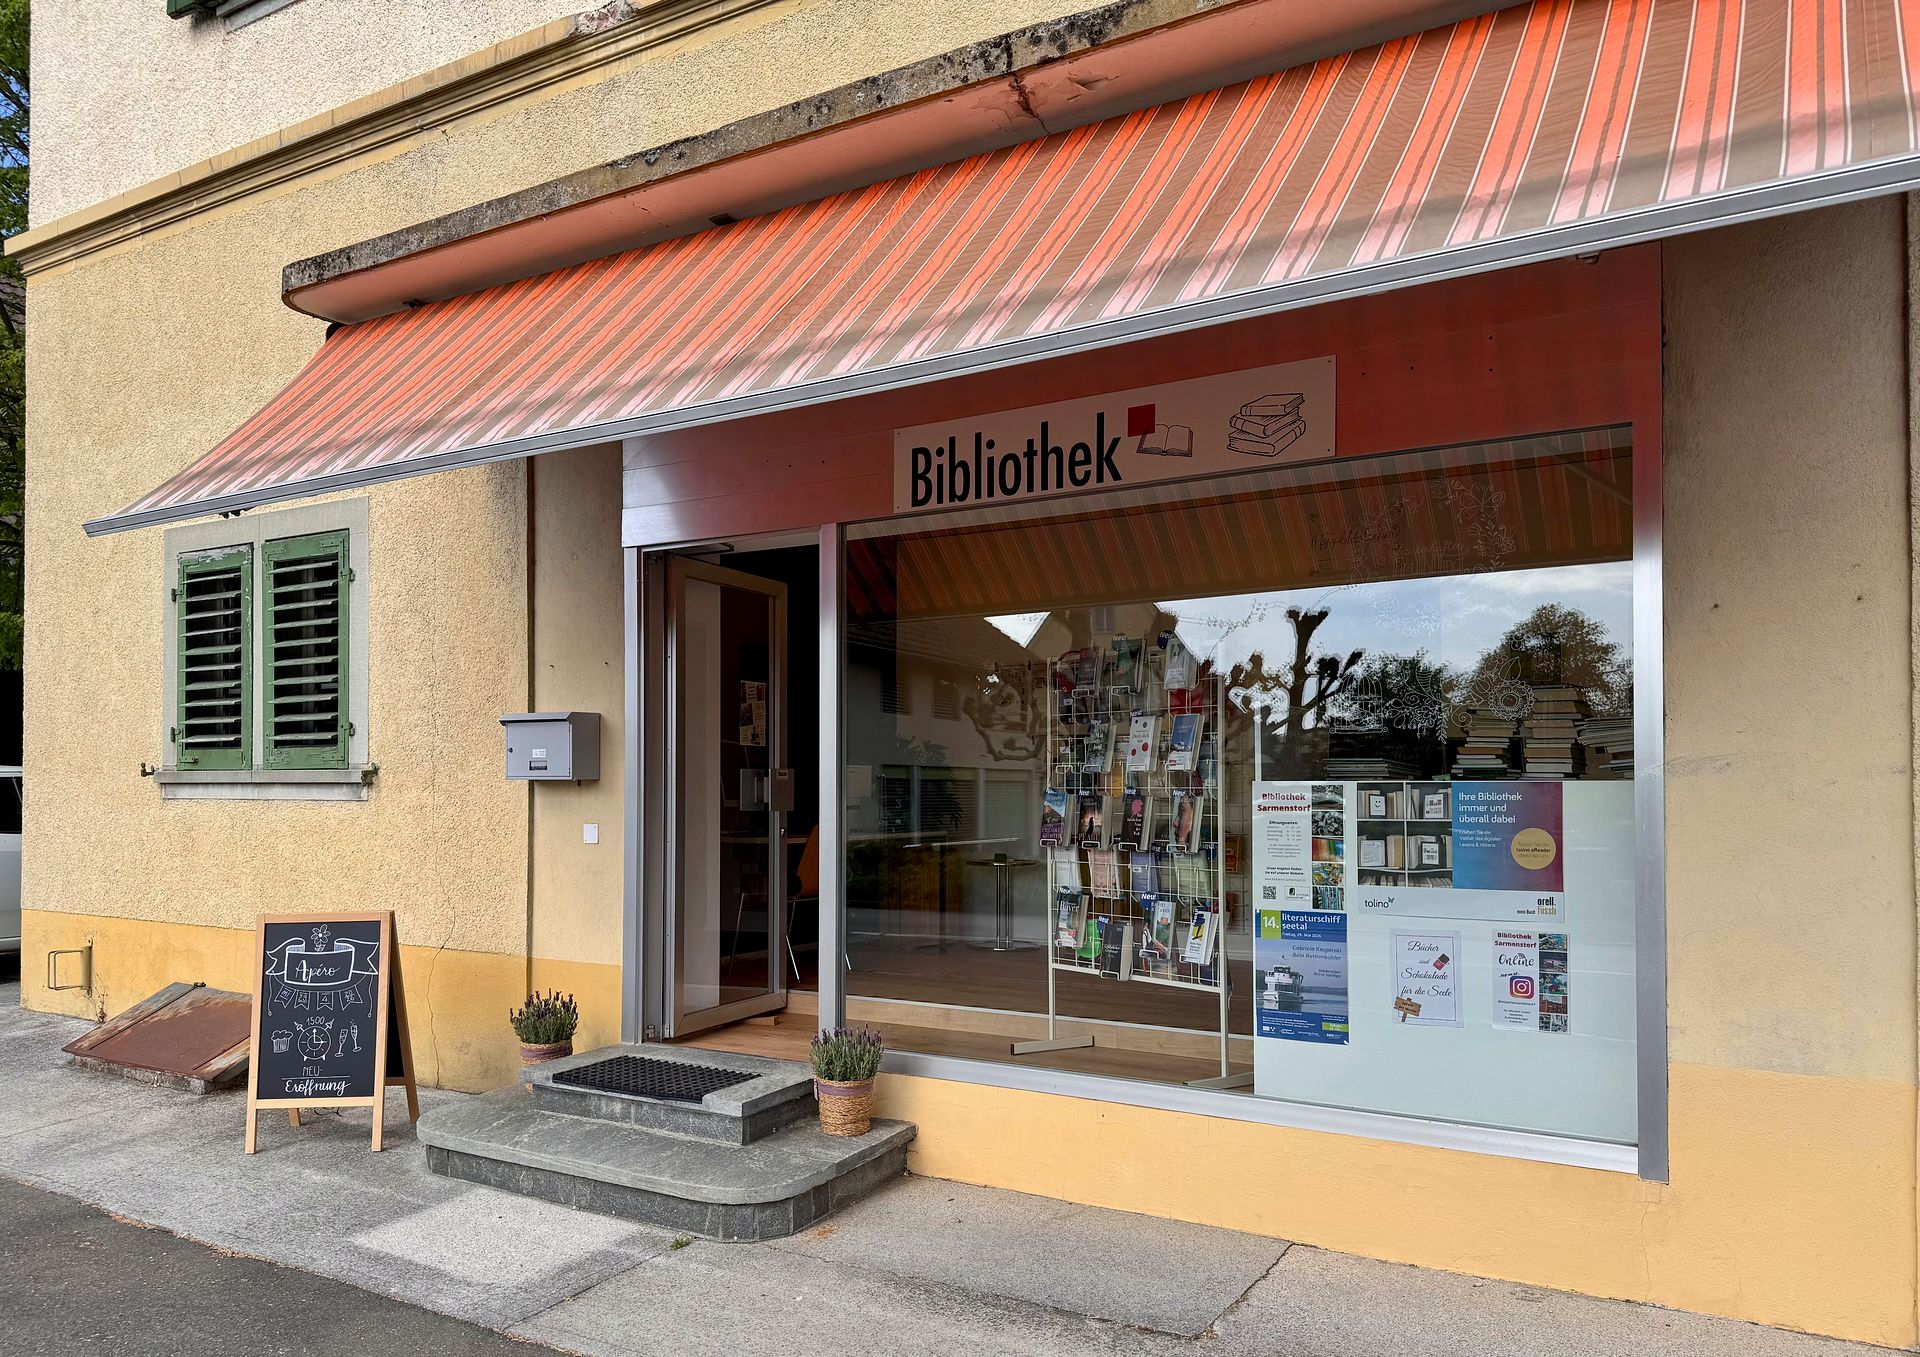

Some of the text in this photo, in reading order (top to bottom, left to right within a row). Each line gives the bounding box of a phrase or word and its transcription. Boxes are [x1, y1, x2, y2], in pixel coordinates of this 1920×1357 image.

[911, 411, 1123, 507] Bibliothek
[1262, 793, 1306, 801] Bibliothek
[1458, 792, 1522, 801] Ihre Bibliothek
[1257, 804, 1311, 812] Sarmenstorf
[1459, 803, 1507, 812] immer und
[1459, 814, 1516, 823] überall dabei
[1365, 898, 1389, 909] tolino
[1262, 916, 1279, 929] 14.
[1282, 913, 1341, 923] literaturschiff
[1282, 922, 1308, 930] seetal
[1497, 932, 1532, 940] Bibliothek
[1494, 940, 1537, 948] Sarmenstorf
[1498, 953, 1535, 967] Online
[295, 959, 340, 983] Apéro
[1401, 967, 1448, 980] Schokolade
[1414, 987, 1426, 995] die
[1427, 985, 1452, 997] Seele
[285, 1079, 351, 1096] Eröffnung
